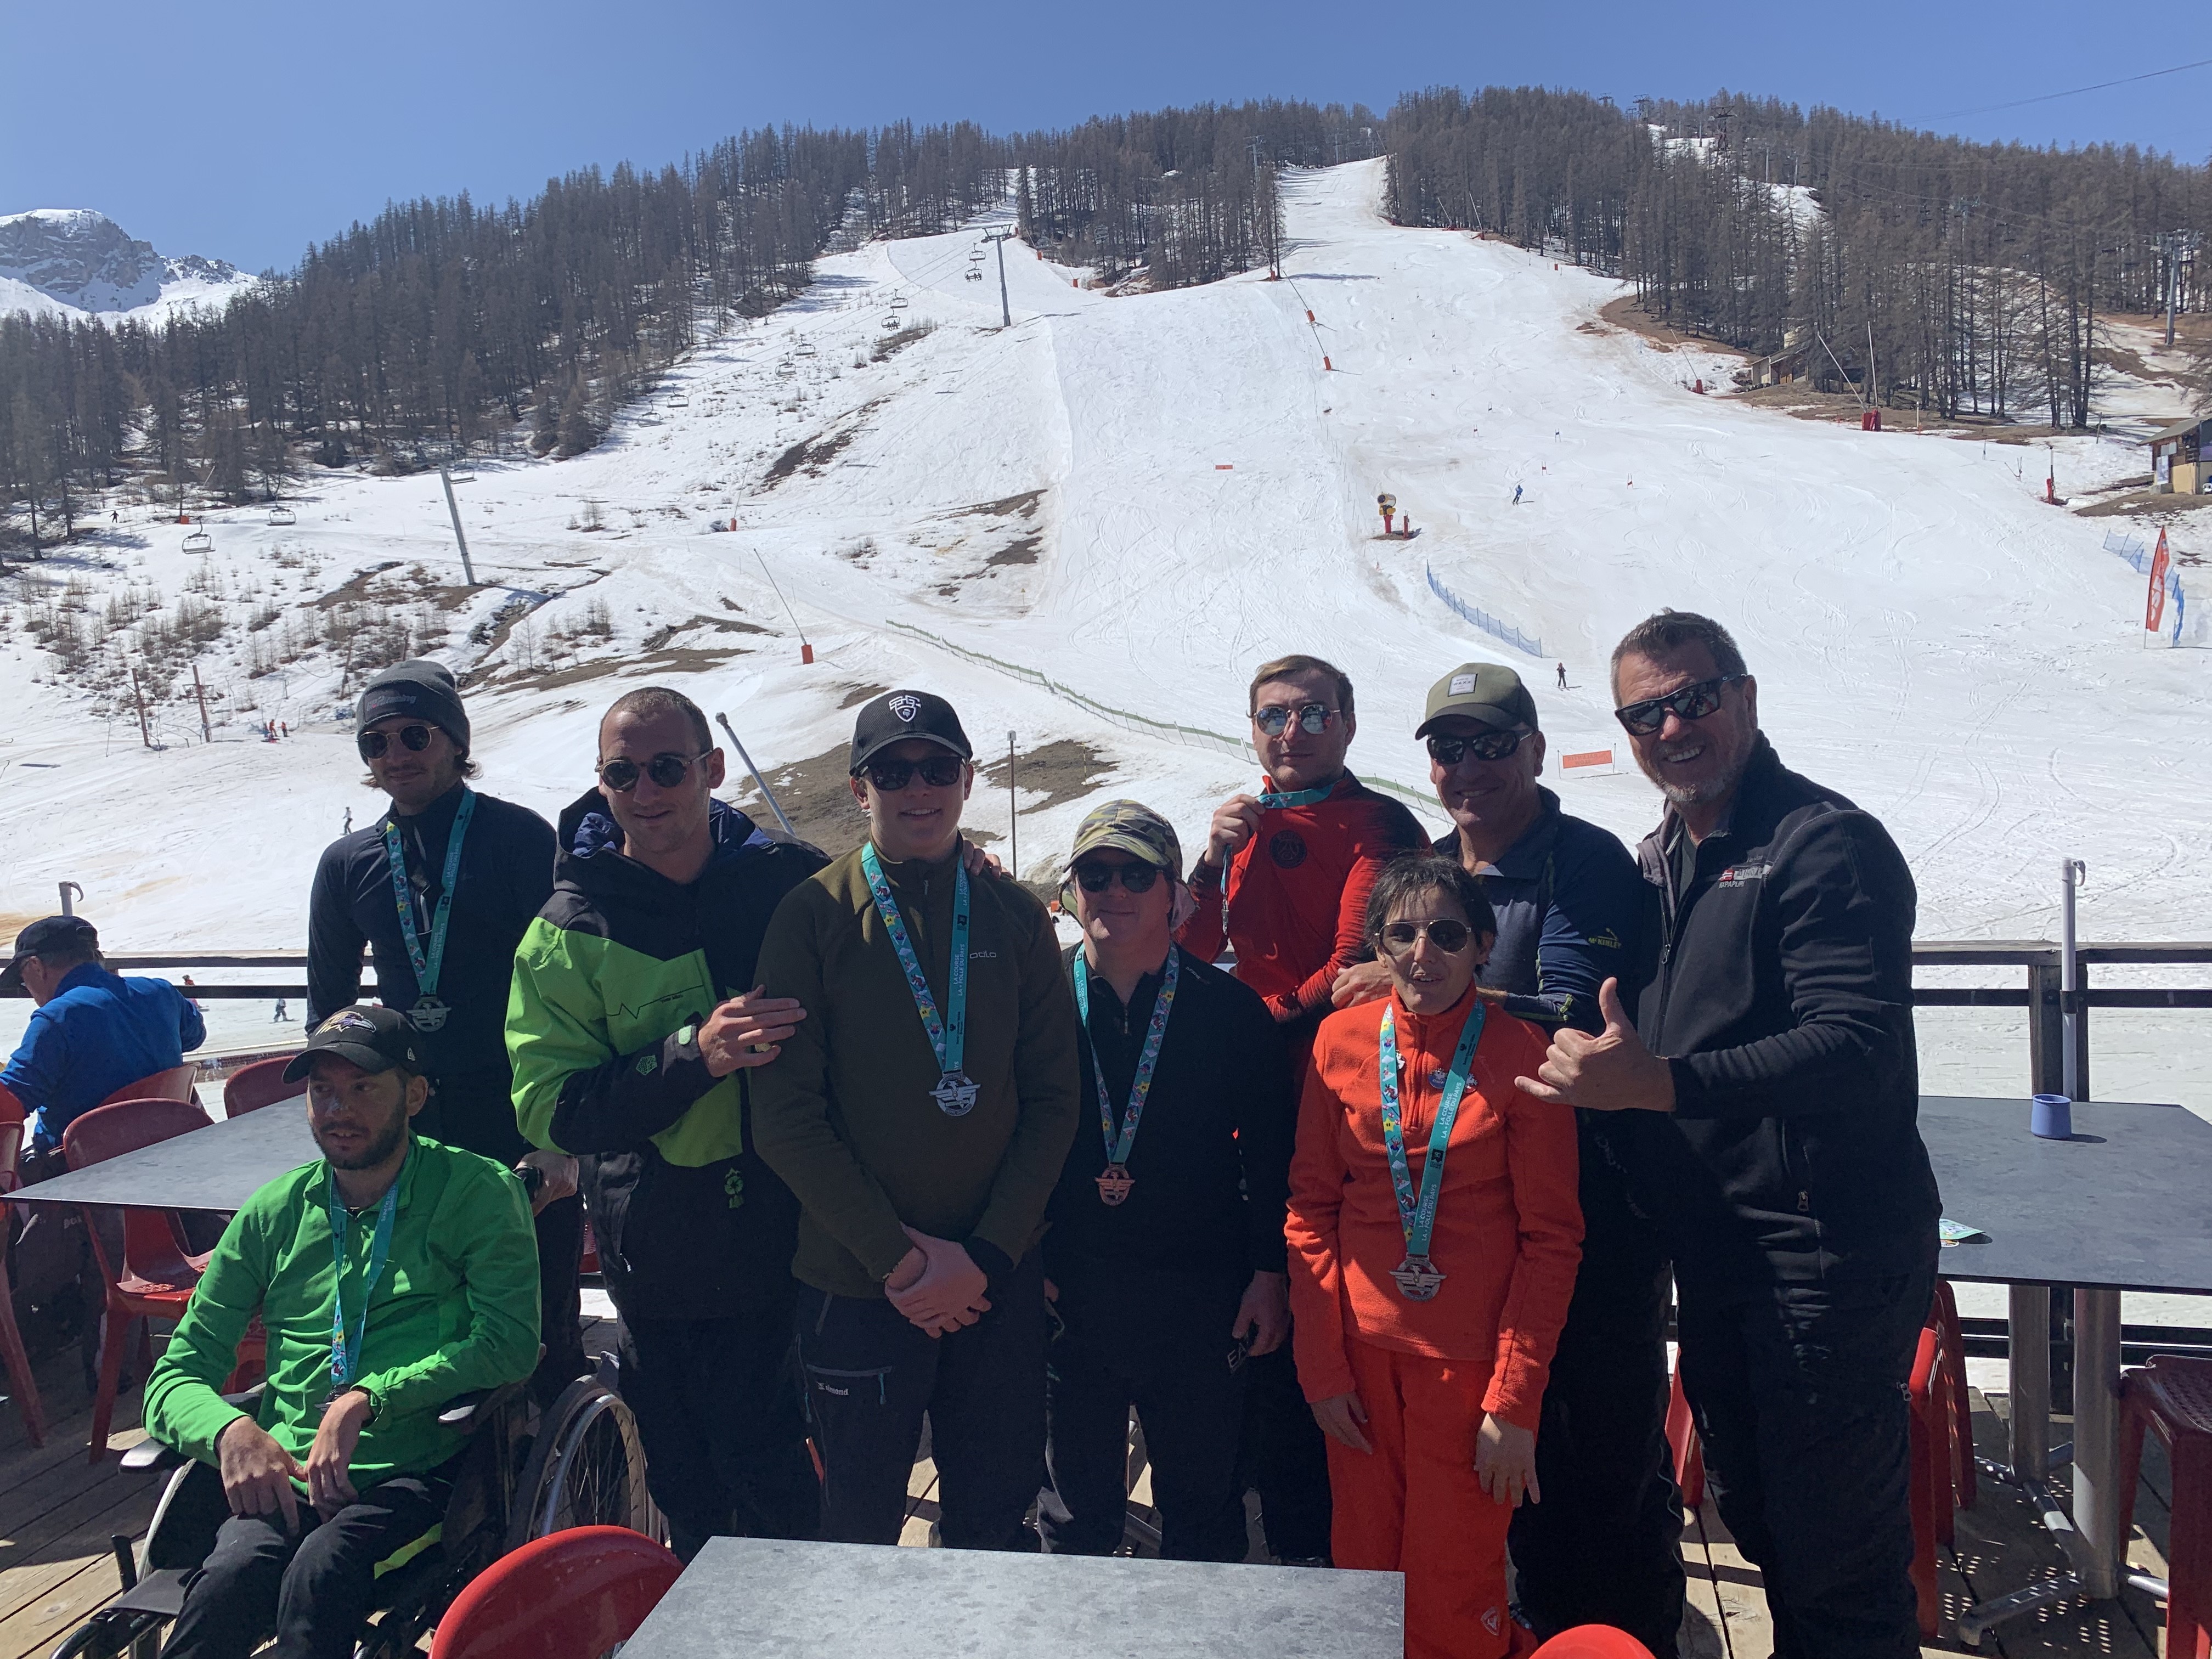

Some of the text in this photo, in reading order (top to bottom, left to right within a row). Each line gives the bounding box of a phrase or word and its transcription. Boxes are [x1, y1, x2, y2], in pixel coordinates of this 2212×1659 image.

[969, 950, 997, 959] odlo
[958, 988, 963, 996] LA
[1079, 998, 1084, 1006] DU
[1441, 1130, 1447, 1138] LA
[1444, 1107, 1454, 1126] FOLLE
[1450, 1098, 1457, 1107] DU
[1454, 1082, 1462, 1098] PAYS
[1442, 1092, 1453, 1117] COURSE
[1420, 1195, 1430, 1220] COURSE
[1427, 1200, 1435, 1209] DU
[1424, 1209, 1433, 1228] FOLLE
[825, 1384, 849, 1396] simond
